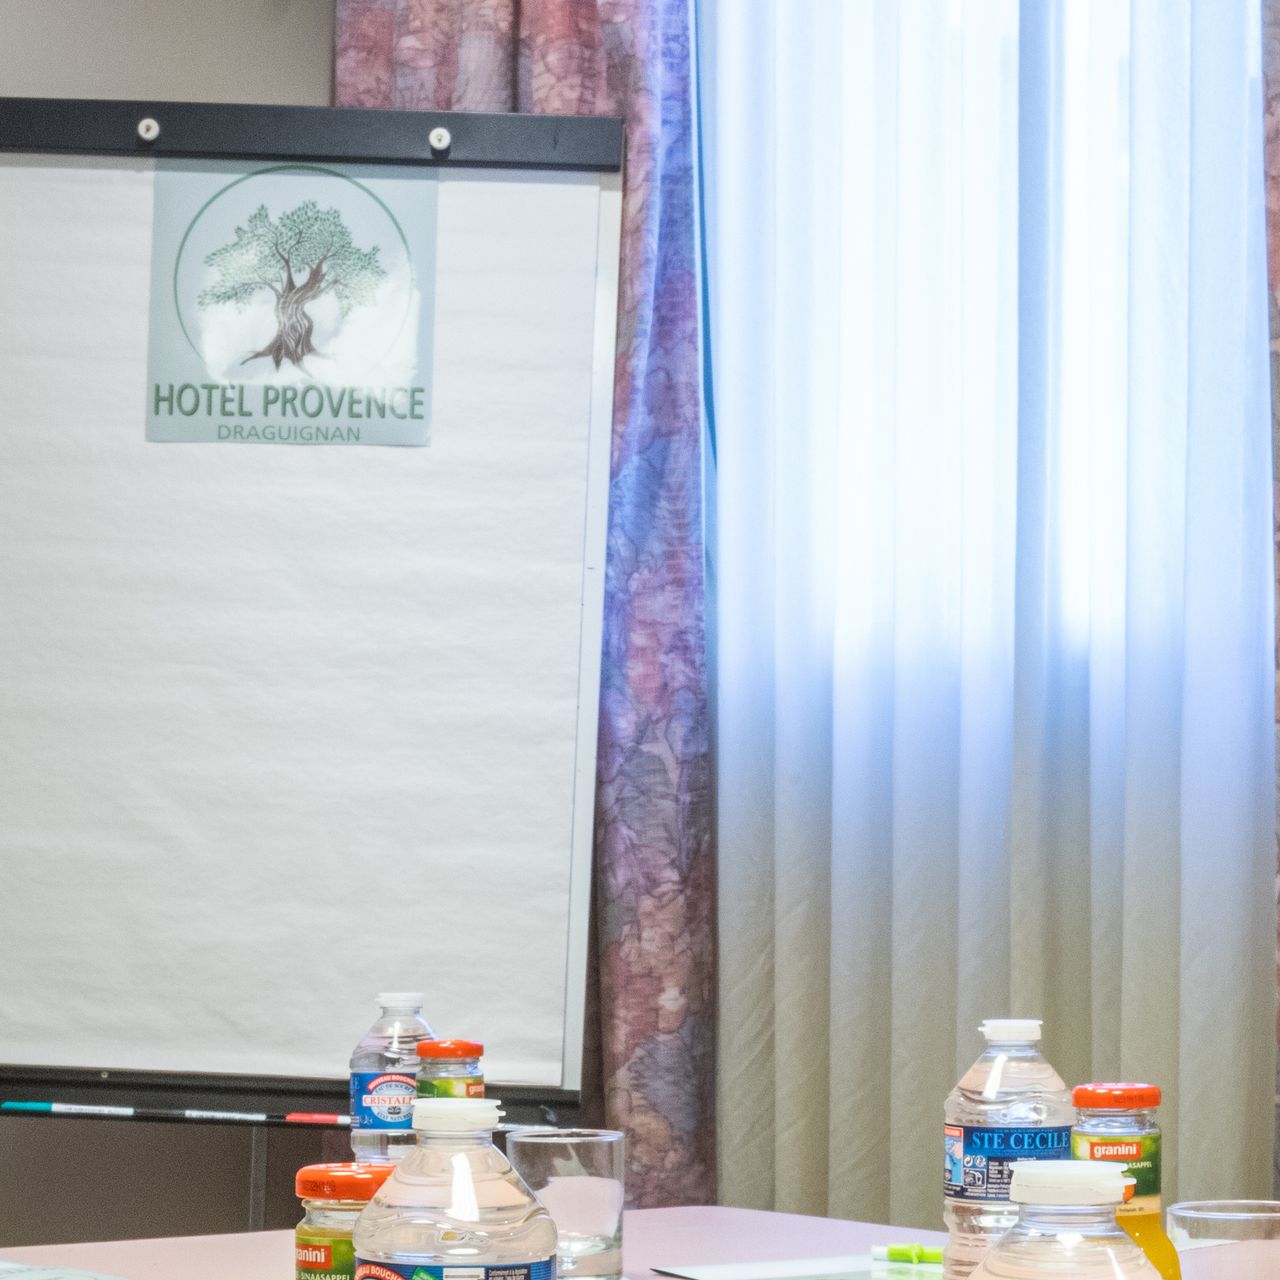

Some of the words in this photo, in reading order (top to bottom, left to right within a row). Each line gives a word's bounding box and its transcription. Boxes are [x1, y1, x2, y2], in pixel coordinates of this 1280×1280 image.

[153, 383, 252, 418] HOTEL
[262, 384, 425, 420] PROVENCE
[217, 425, 361, 442] DRAGUIGNAN
[363, 1096, 415, 1105] CRISTALI
[971, 1131, 1005, 1149] STE
[1010, 1131, 1070, 1150] CECILE
[1093, 1143, 1137, 1158] granini
[297, 1247, 325, 1263] anini
